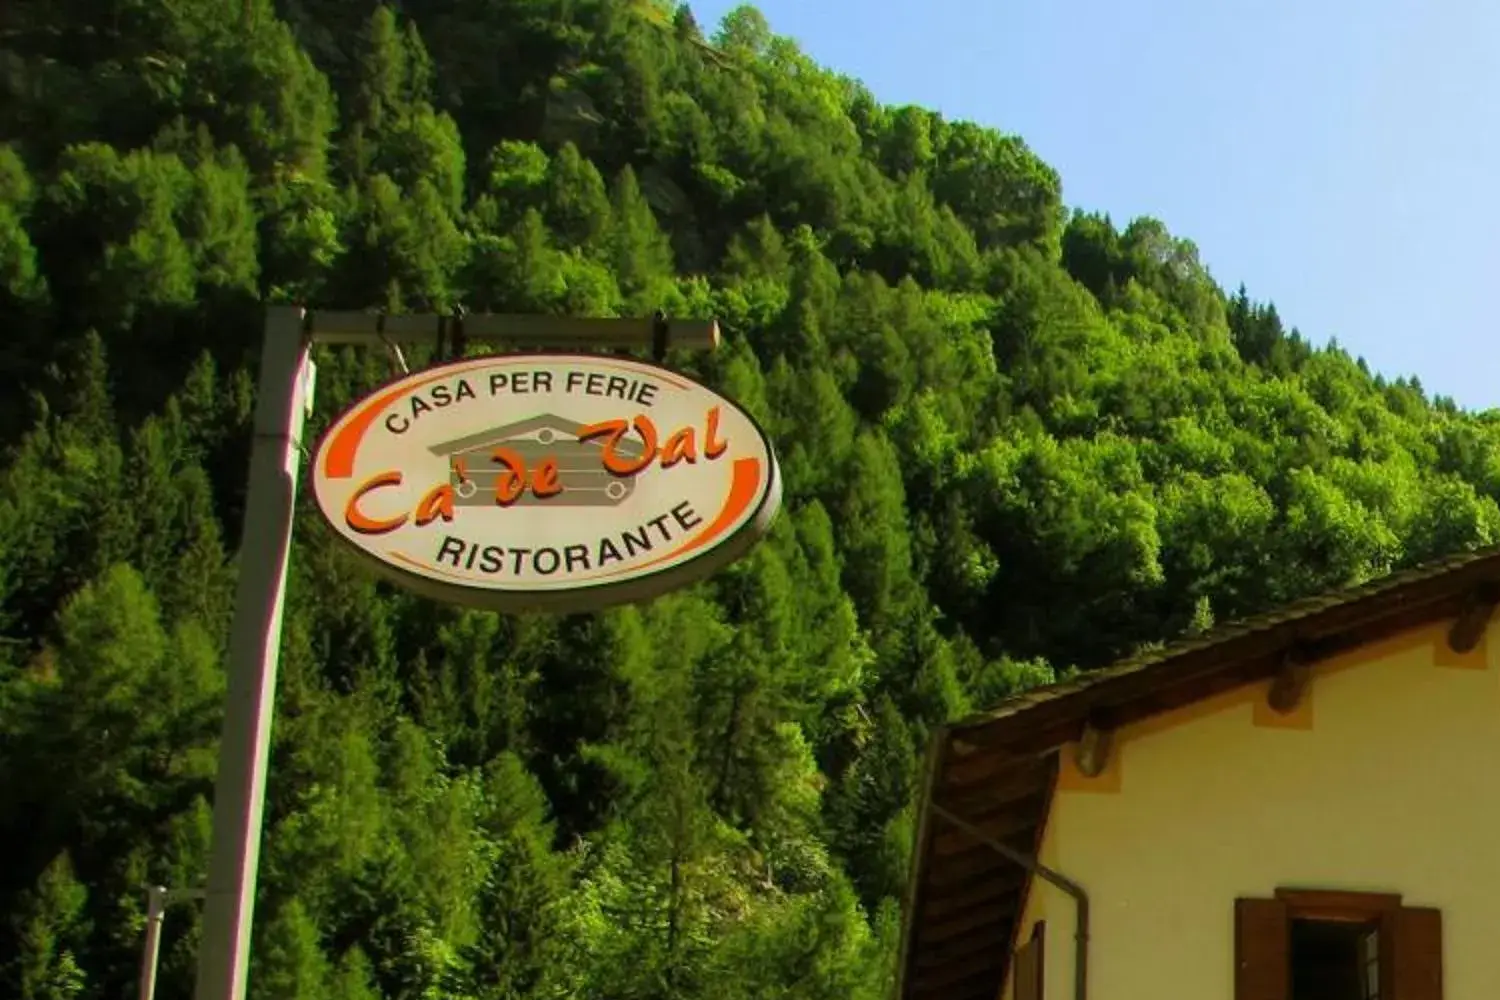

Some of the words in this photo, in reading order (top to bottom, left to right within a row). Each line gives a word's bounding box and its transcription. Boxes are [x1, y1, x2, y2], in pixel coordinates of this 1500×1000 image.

[385, 380, 476, 435] CASA
[489, 371, 552, 396] PER
[566, 371, 660, 407] FERIE
[491, 446, 564, 508] de
[577, 405, 729, 479] Val
[436, 500, 703, 576] RISTORANTE
